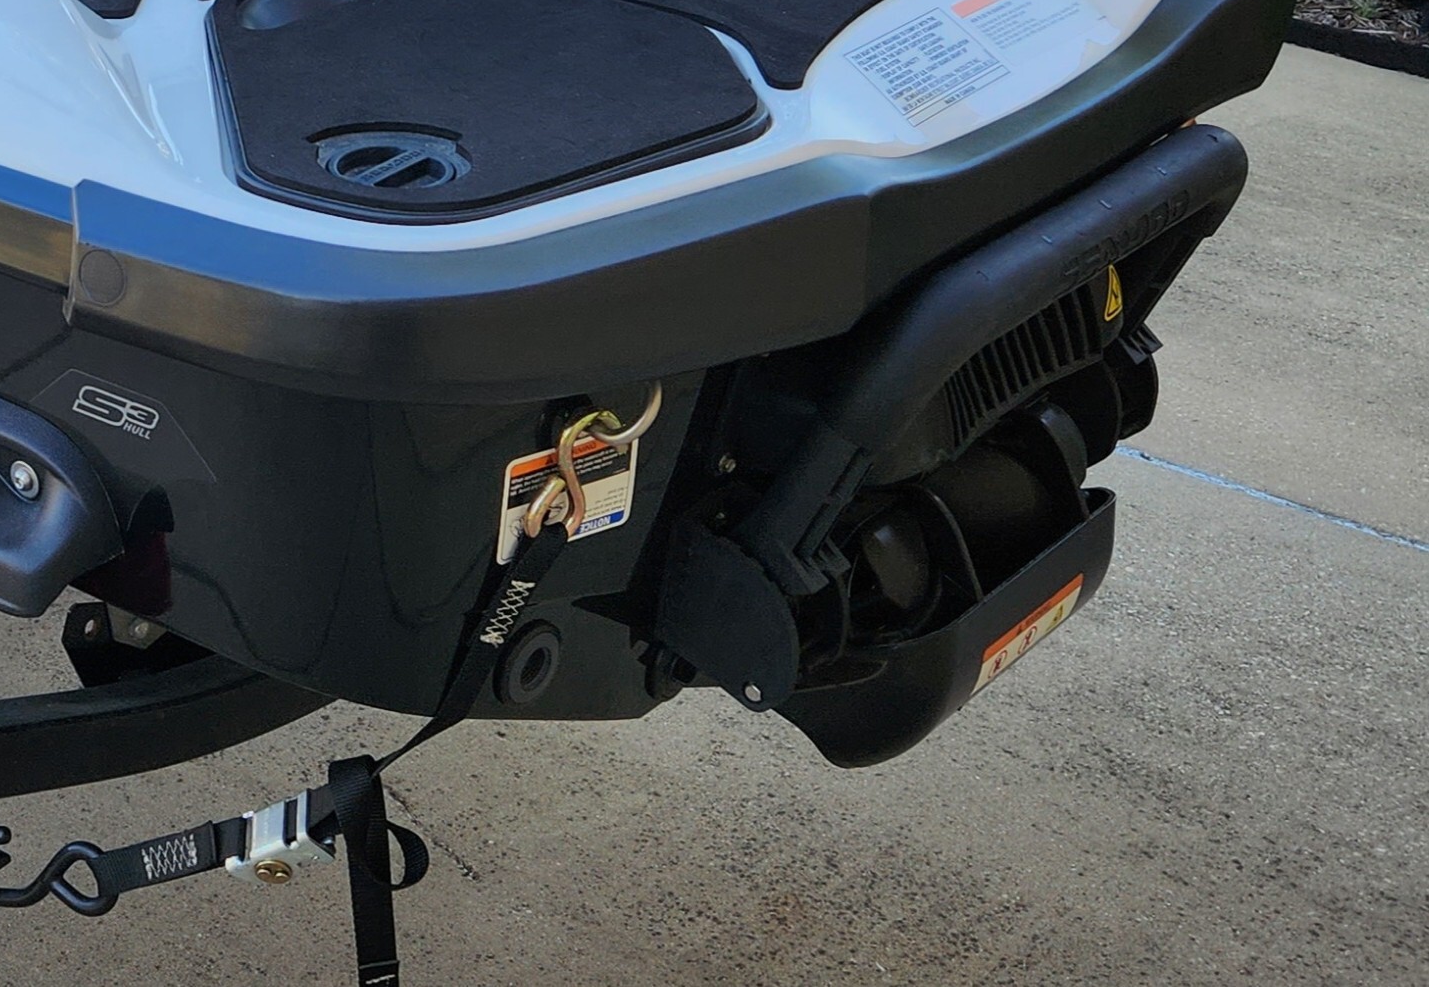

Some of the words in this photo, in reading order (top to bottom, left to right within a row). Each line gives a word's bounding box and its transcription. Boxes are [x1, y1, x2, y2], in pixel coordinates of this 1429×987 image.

[72, 385, 160, 430] S3
[122, 421, 151, 440] HULL
[578, 515, 612, 535] NOTICE
